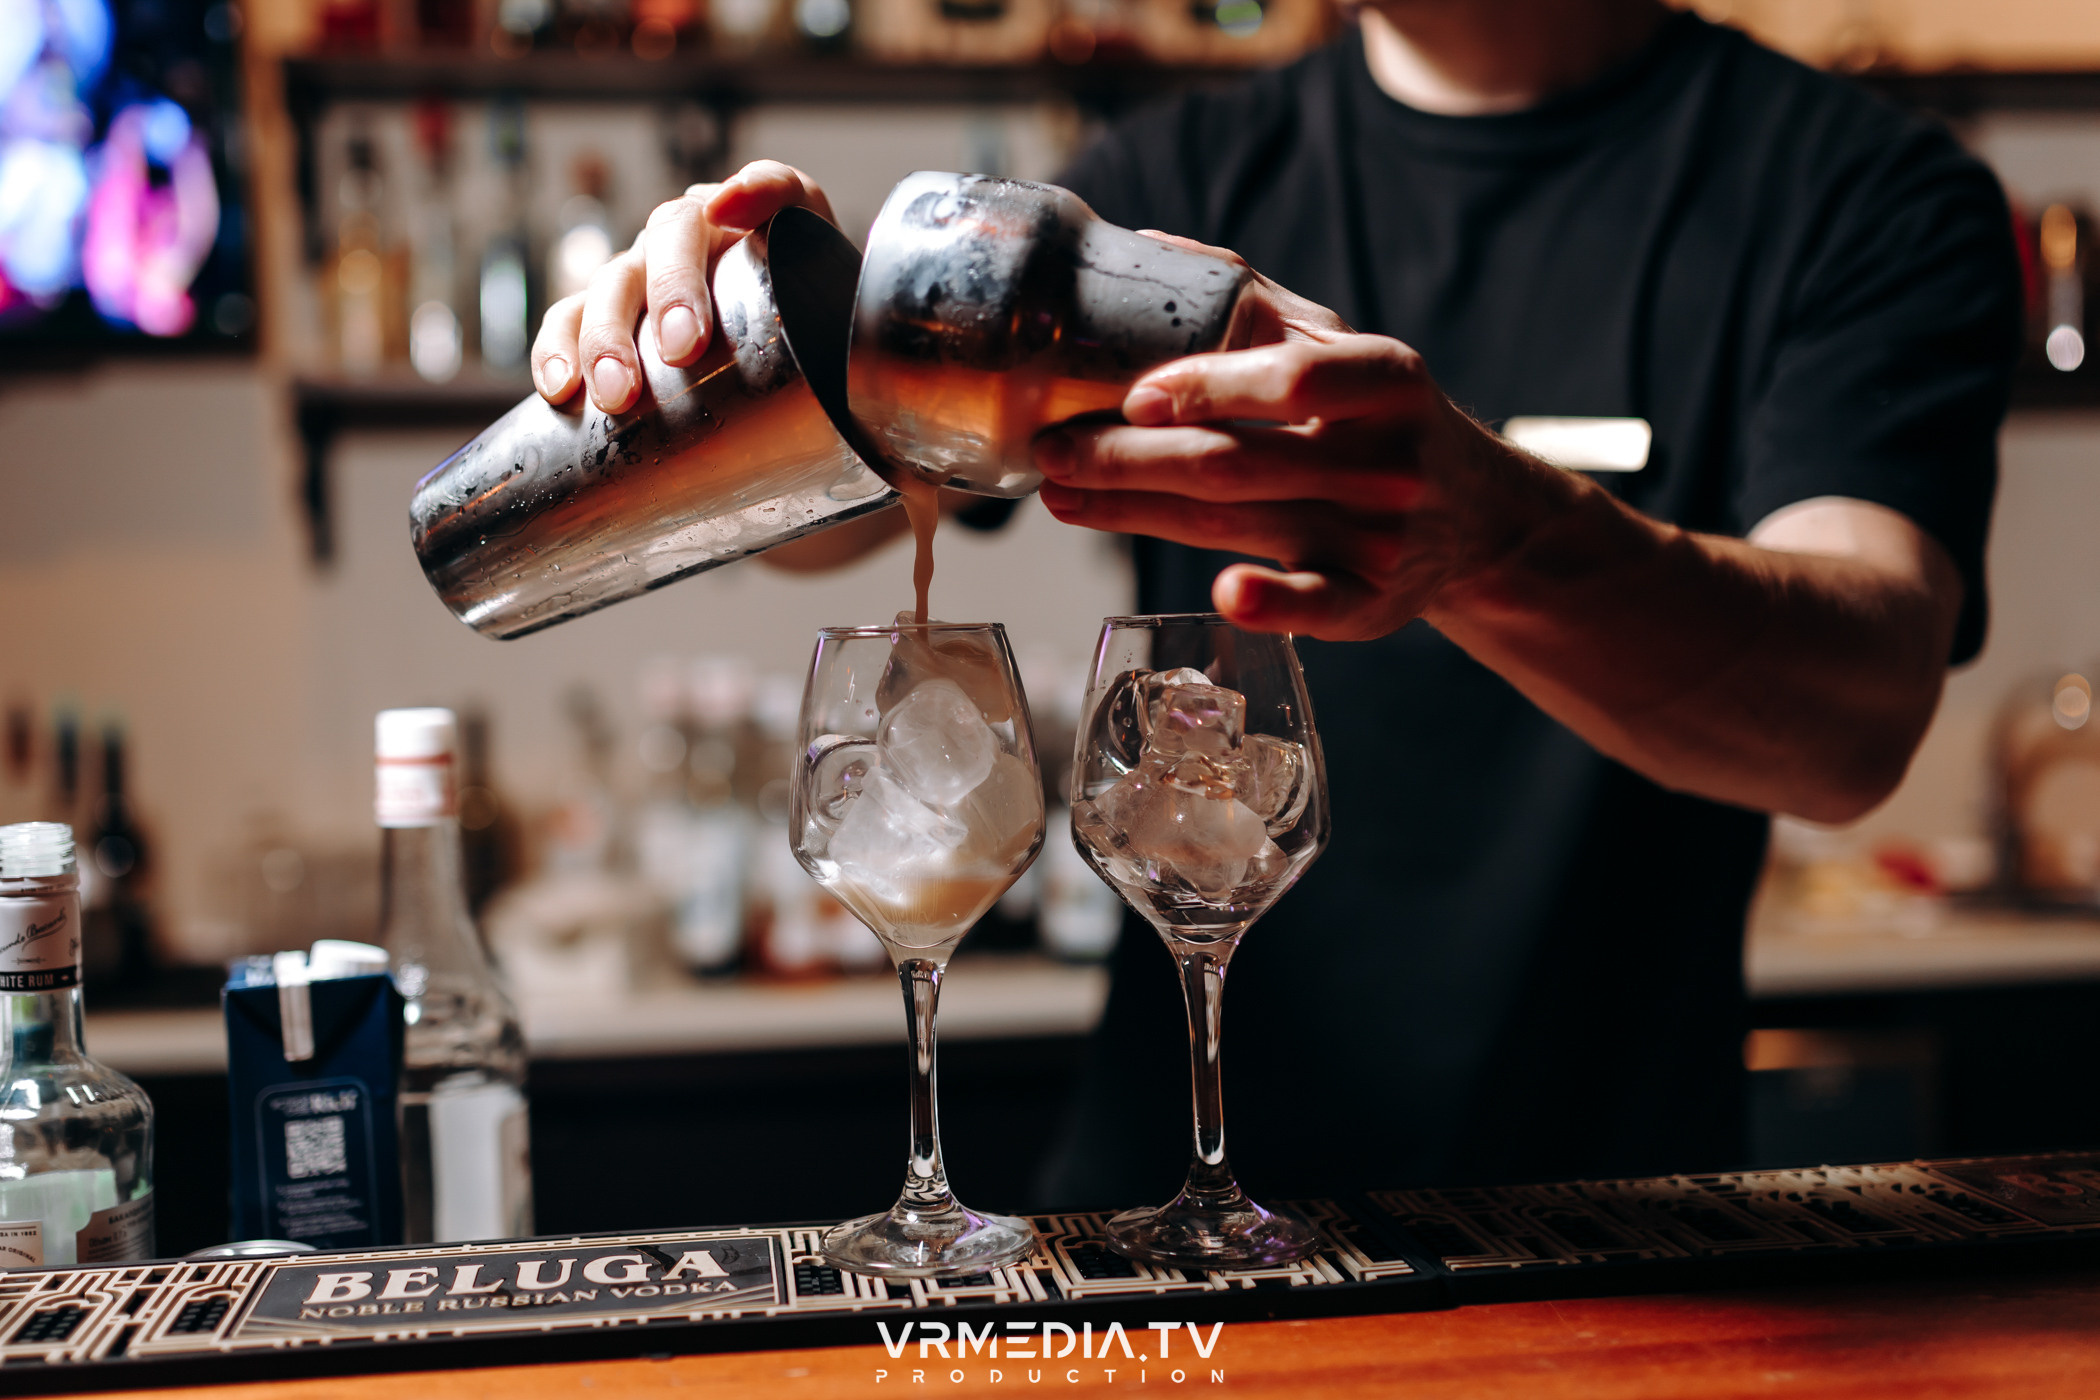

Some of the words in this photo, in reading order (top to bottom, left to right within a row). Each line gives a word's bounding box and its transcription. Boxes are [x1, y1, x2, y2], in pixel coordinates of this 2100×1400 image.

[0, 976, 25, 989] HITE
[28, 975, 54, 988] RUM
[303, 1250, 730, 1304] BELUGA
[299, 1300, 424, 1320] NOBLE
[437, 1289, 599, 1312] RUSSIAN
[609, 1280, 738, 1299] VODKA
